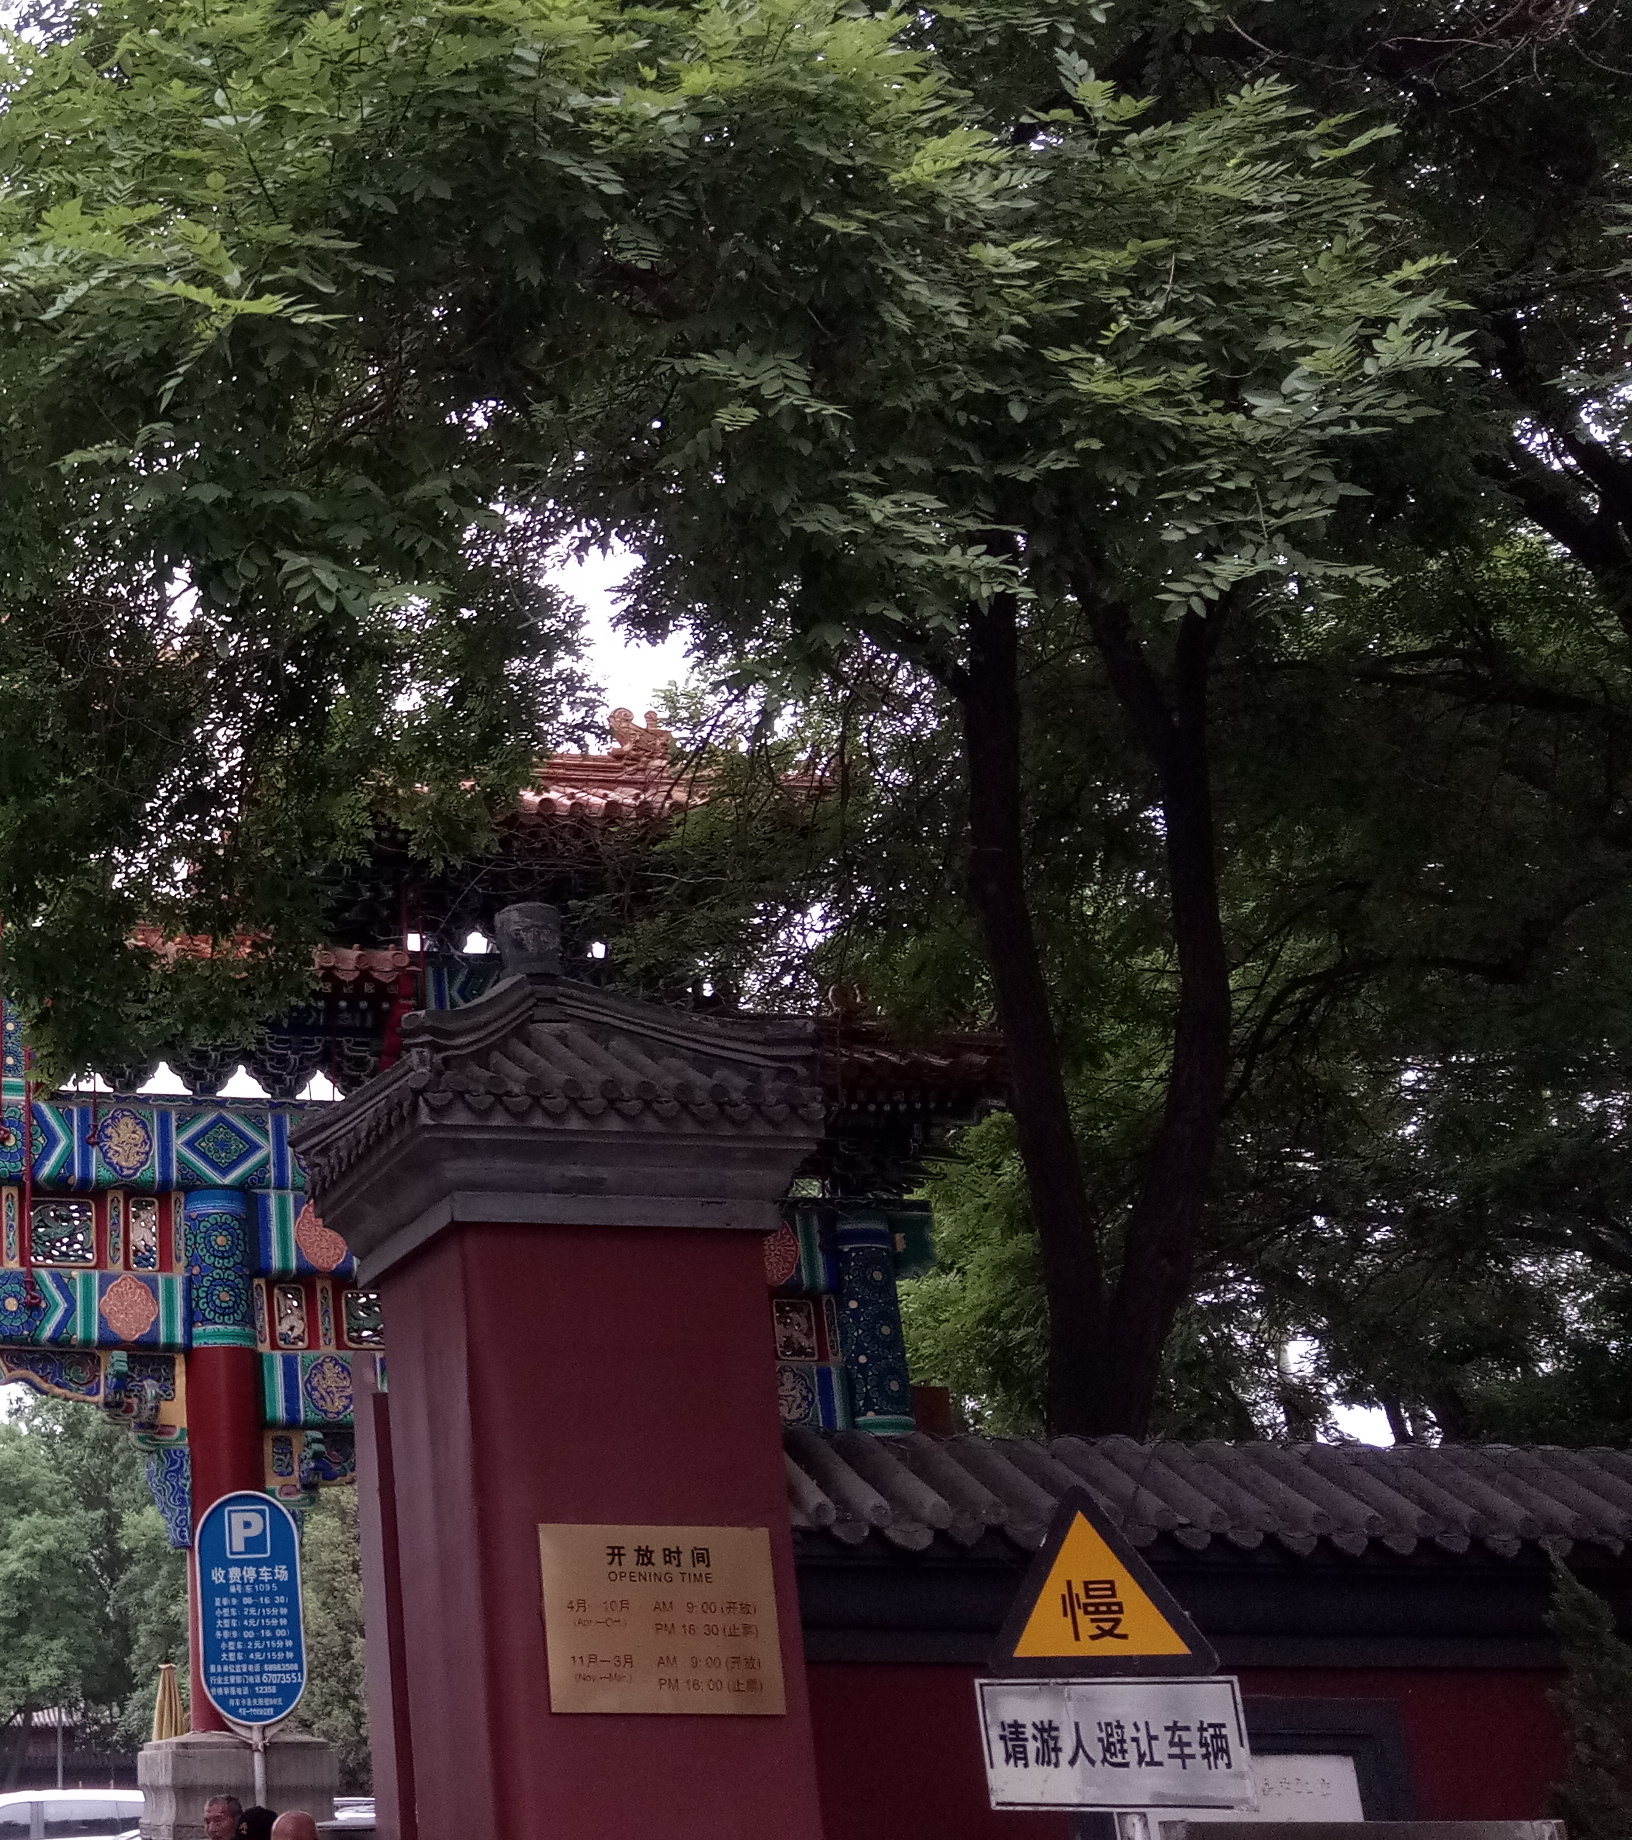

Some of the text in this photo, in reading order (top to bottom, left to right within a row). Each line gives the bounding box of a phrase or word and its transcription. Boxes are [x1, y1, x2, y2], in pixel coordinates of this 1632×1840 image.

[231, 1512, 264, 1552] P
[606, 1545, 711, 1568] 开放时间
[211, 1565, 289, 1585] 收费停车场
[608, 1571, 713, 1584] OPENING TIME
[653, 1601, 674, 1612] AM
[1061, 1579, 1129, 1642] 慢
[655, 1623, 676, 1634] PM
[657, 1656, 677, 1667] AM
[659, 1678, 679, 1691] PM
[1000, 1719, 1234, 1770] 请游人避让车辆
